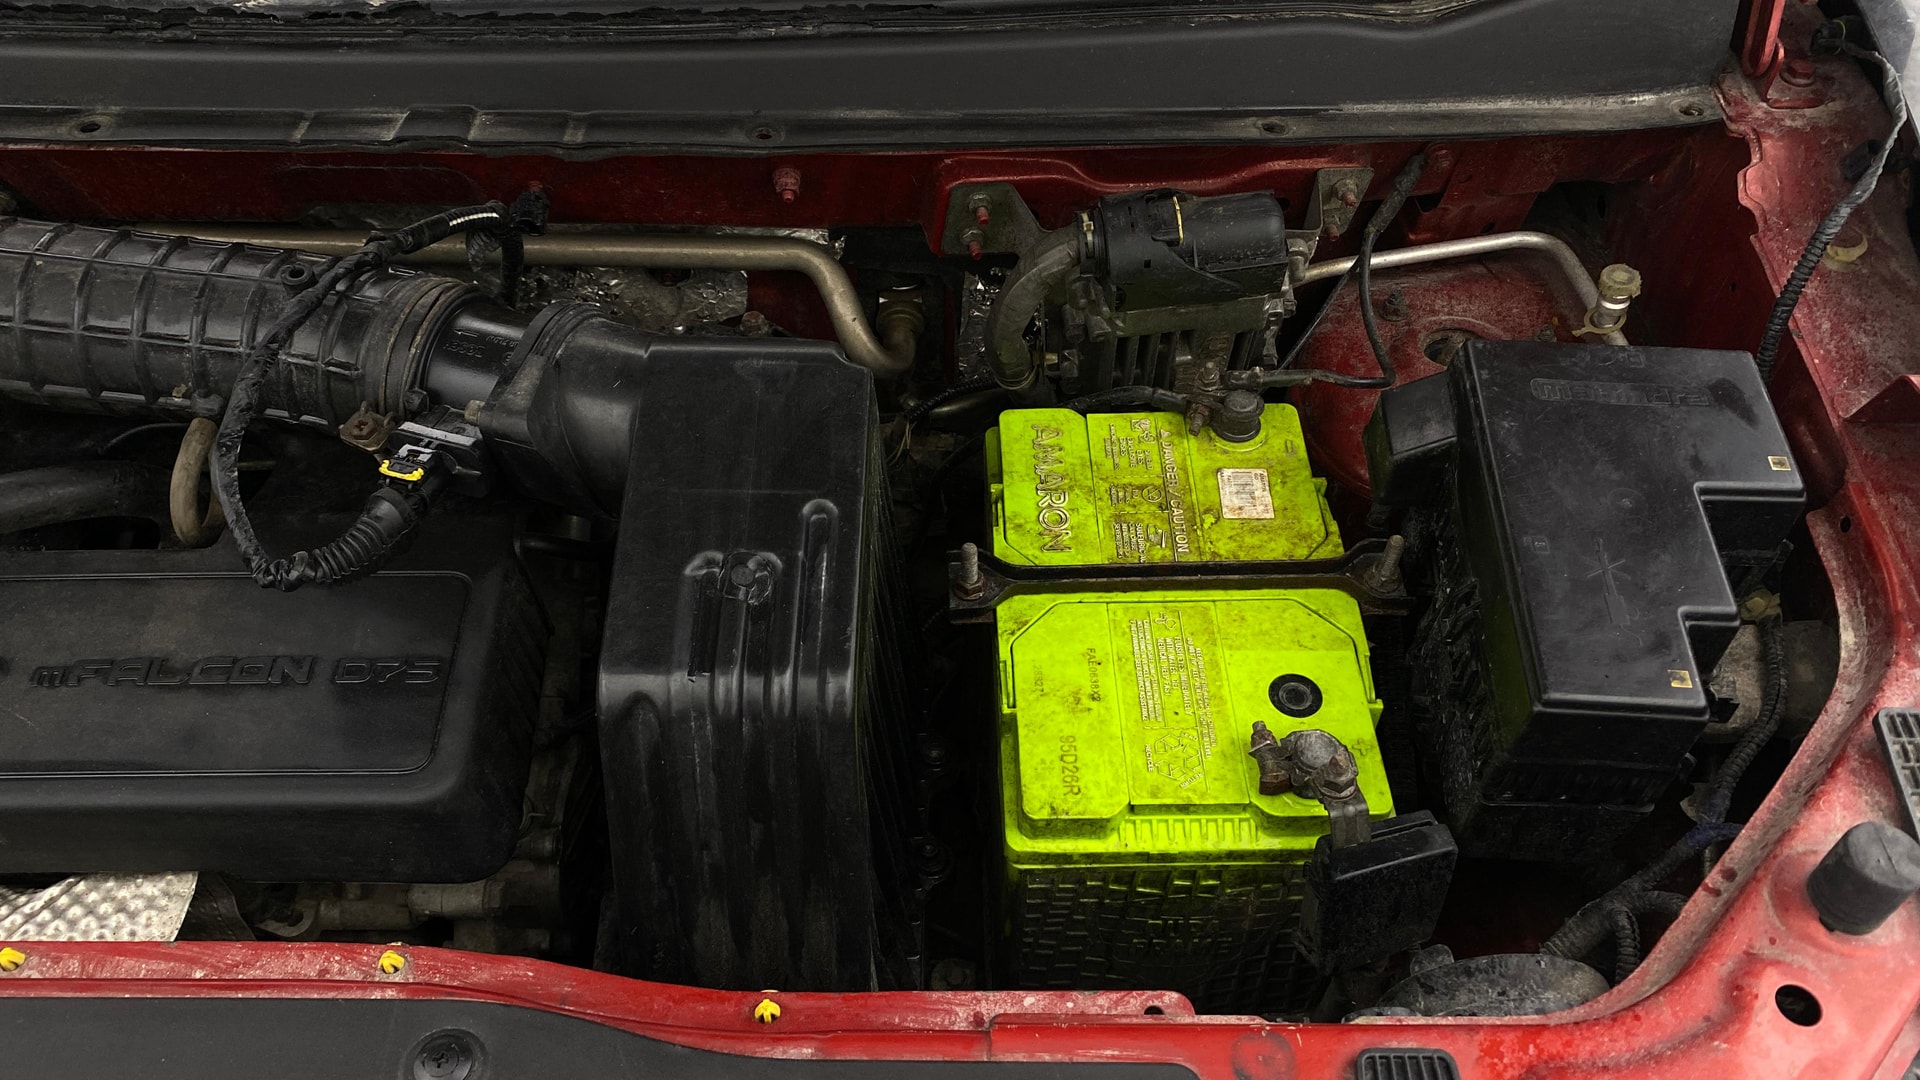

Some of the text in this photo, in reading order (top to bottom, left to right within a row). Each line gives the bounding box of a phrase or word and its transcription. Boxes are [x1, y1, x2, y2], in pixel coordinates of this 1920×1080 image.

[1031, 424, 1072, 553] AMARON
[1161, 441, 1178, 488] DANGER
[1170, 499, 1190, 553] CAUTION
[1135, 523, 1146, 553] SULFURIC
[1157, 638, 1168, 662] MEDICAL
[335, 659, 442, 685] D75
[1180, 673, 1193, 716] IMMEDIATELY
[1059, 734, 1081, 797] 95D26R
[1145, 744, 1154, 773] RECYCLE
